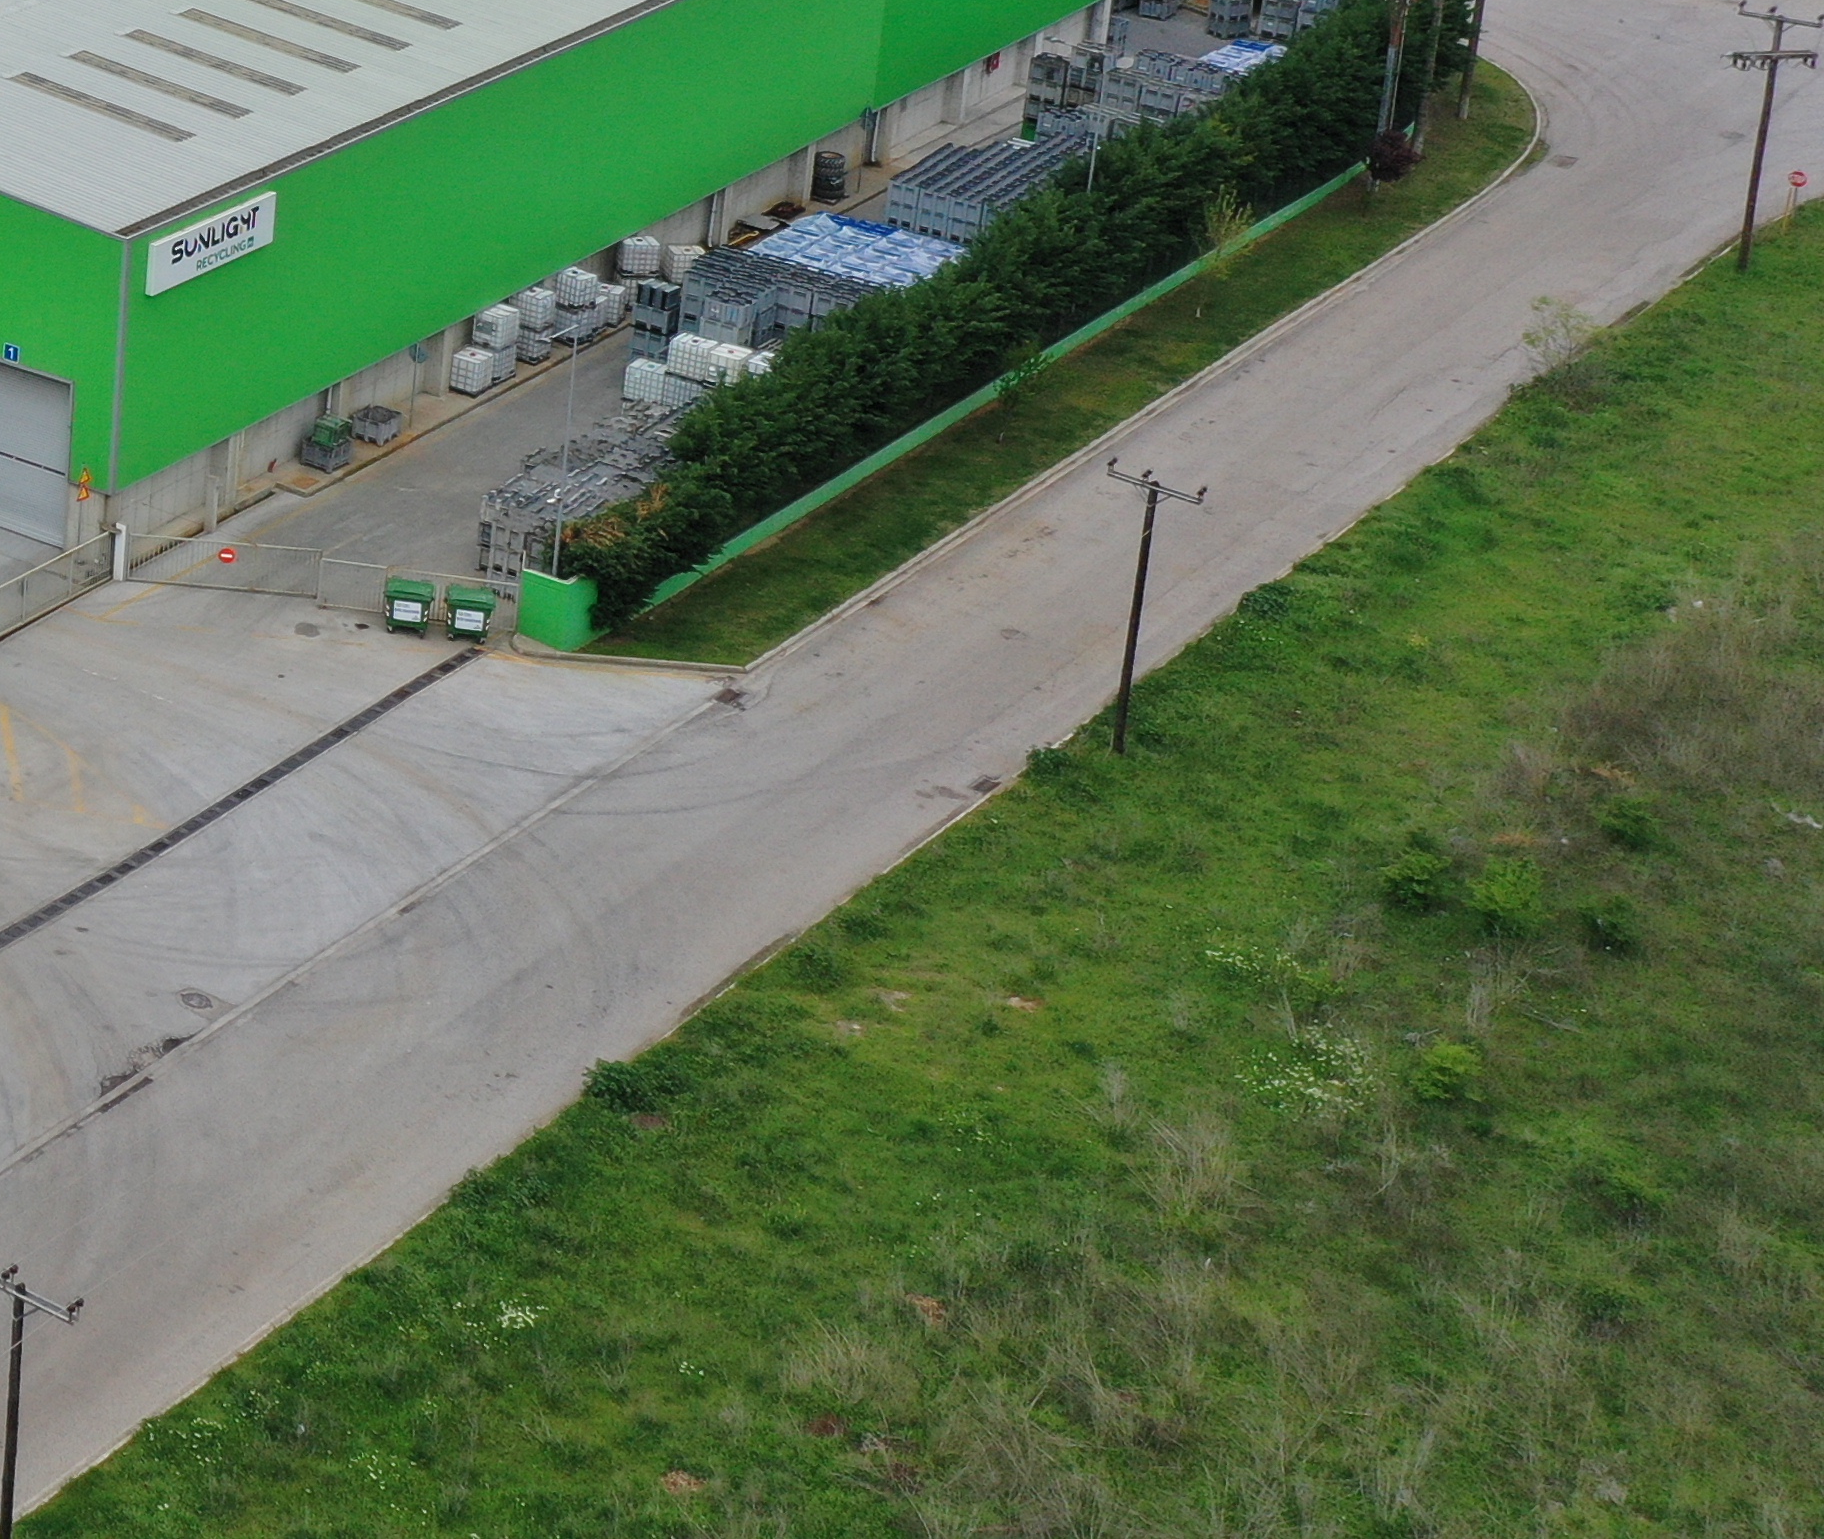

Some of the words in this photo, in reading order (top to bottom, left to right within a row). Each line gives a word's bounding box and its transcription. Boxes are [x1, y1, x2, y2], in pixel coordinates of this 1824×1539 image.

[171, 205, 260, 265] SUNLIGHT
[196, 239, 247, 272] RECYCLING
[8, 347, 14, 359] 1
